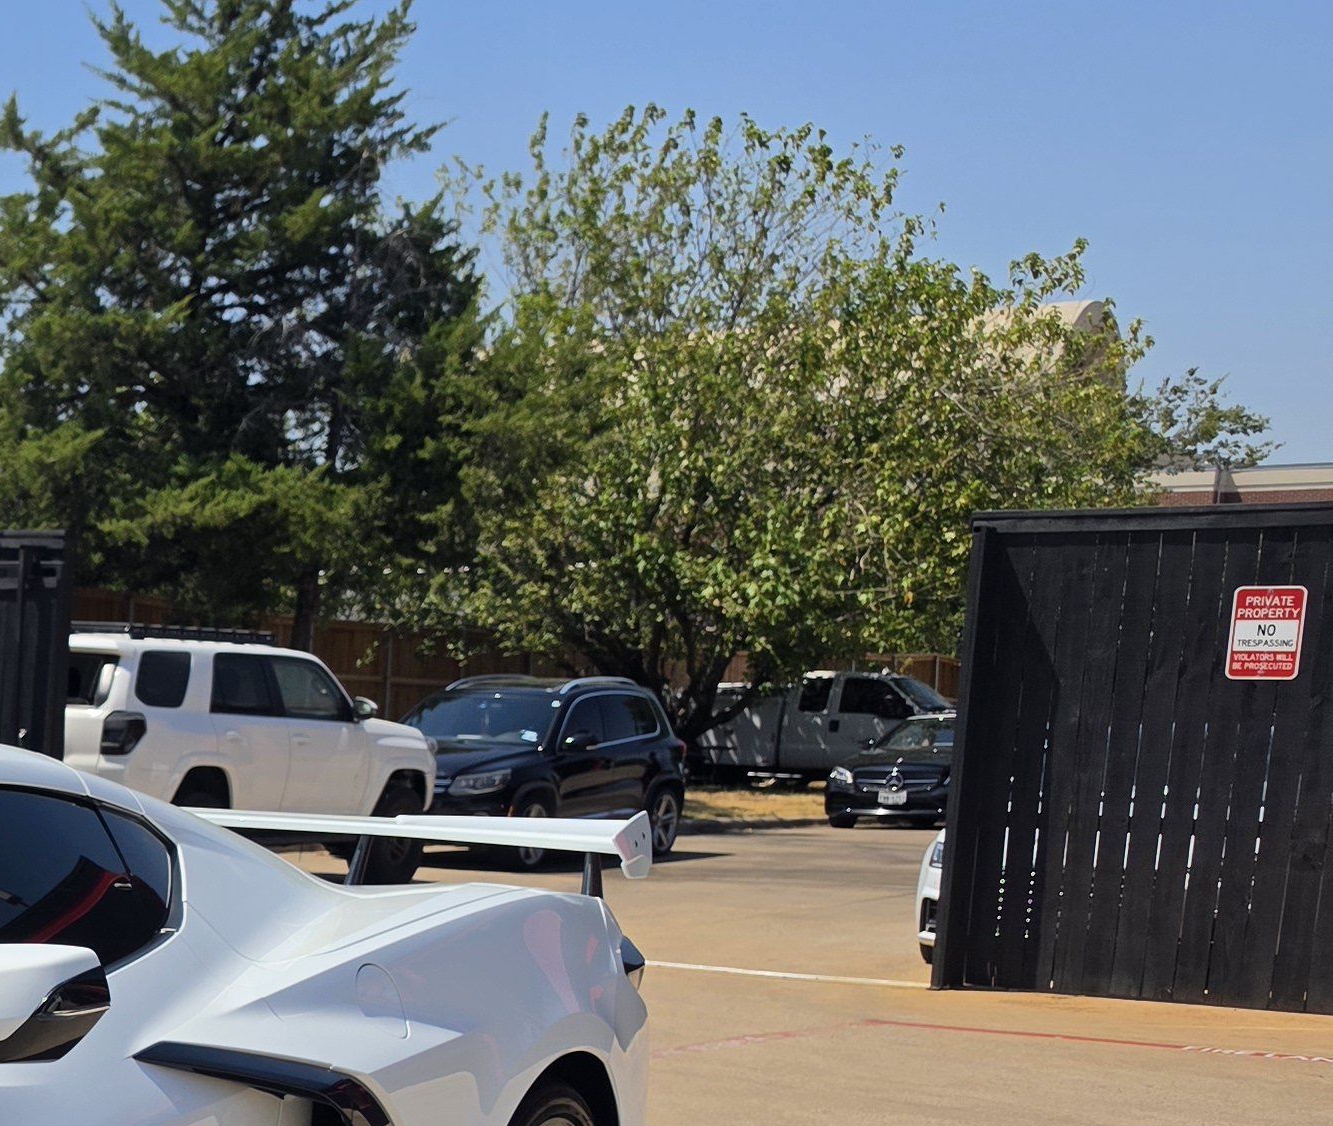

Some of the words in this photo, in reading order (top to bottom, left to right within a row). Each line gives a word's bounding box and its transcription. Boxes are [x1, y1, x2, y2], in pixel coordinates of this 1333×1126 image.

[1245, 595, 1295, 606] PRIVATE
[1237, 607, 1300, 618] PROPERTY
[1257, 624, 1277, 637] NO
[1237, 639, 1294, 648] TRESPASSING
[1233, 653, 1274, 661] VIOLATORS
[1276, 653, 1293, 661] WILL
[1232, 661, 1242, 669] BE
[1243, 662, 1292, 670] PROSECUTED
